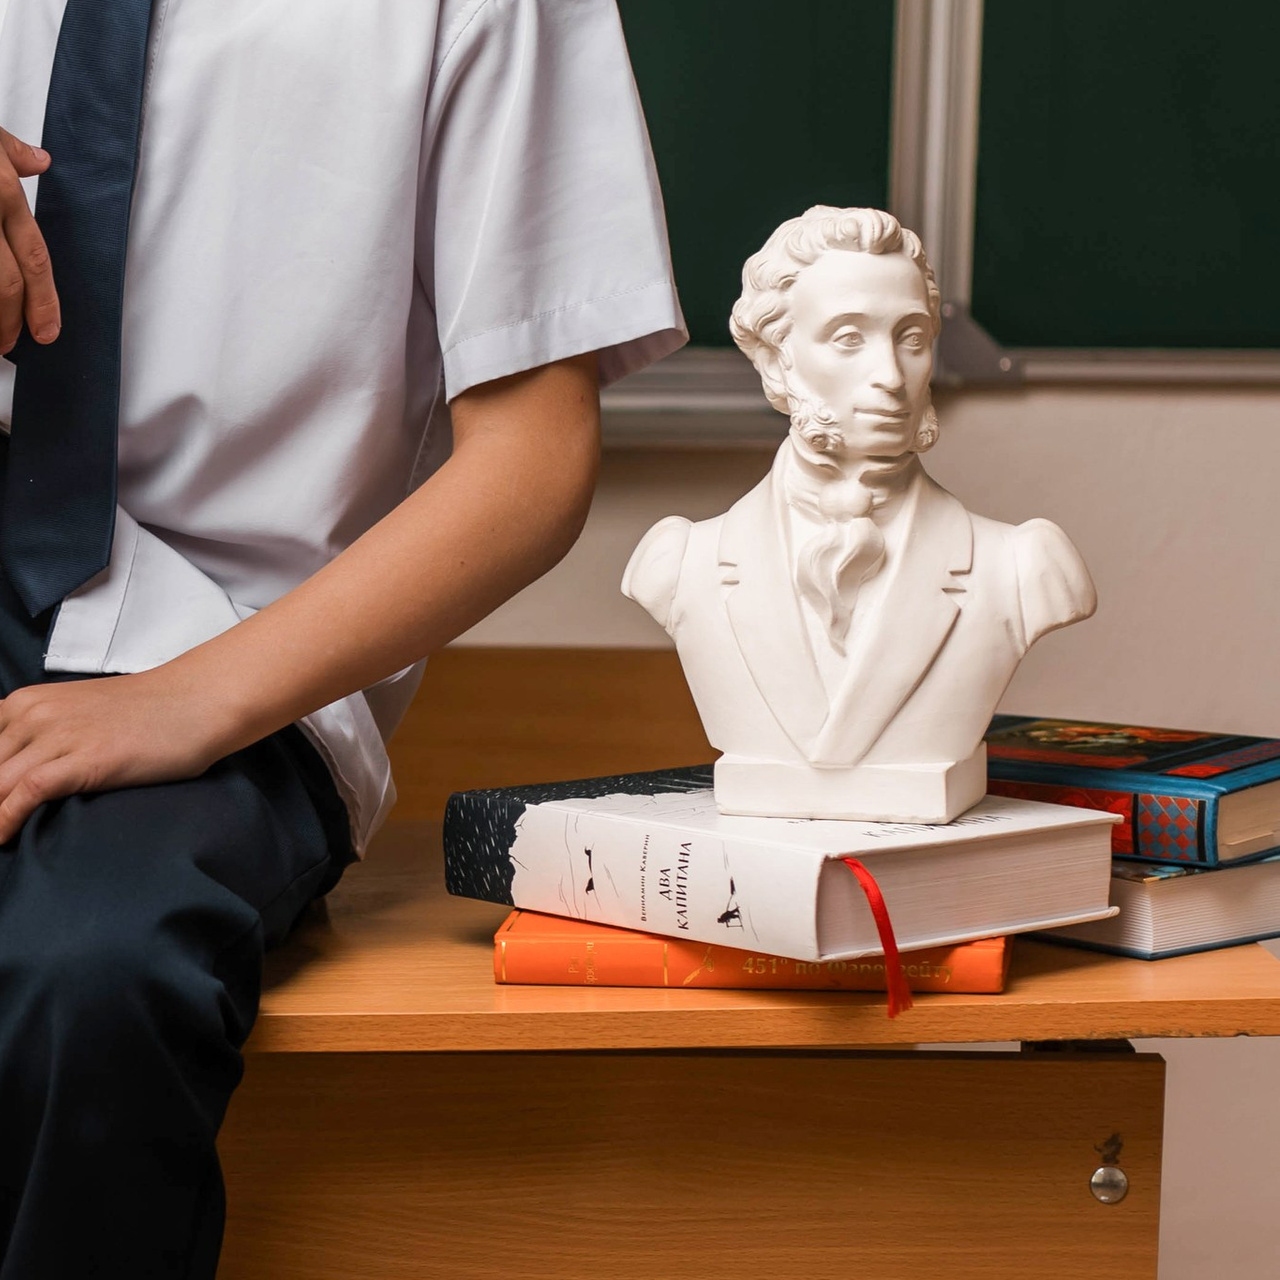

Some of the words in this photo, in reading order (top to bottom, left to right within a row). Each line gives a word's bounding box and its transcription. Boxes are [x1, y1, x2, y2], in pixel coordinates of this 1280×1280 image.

[658, 867, 673, 901] ДВА
[677, 841, 693, 931] КАПИТАНА
[824, 960, 955, 984] Фареейту
